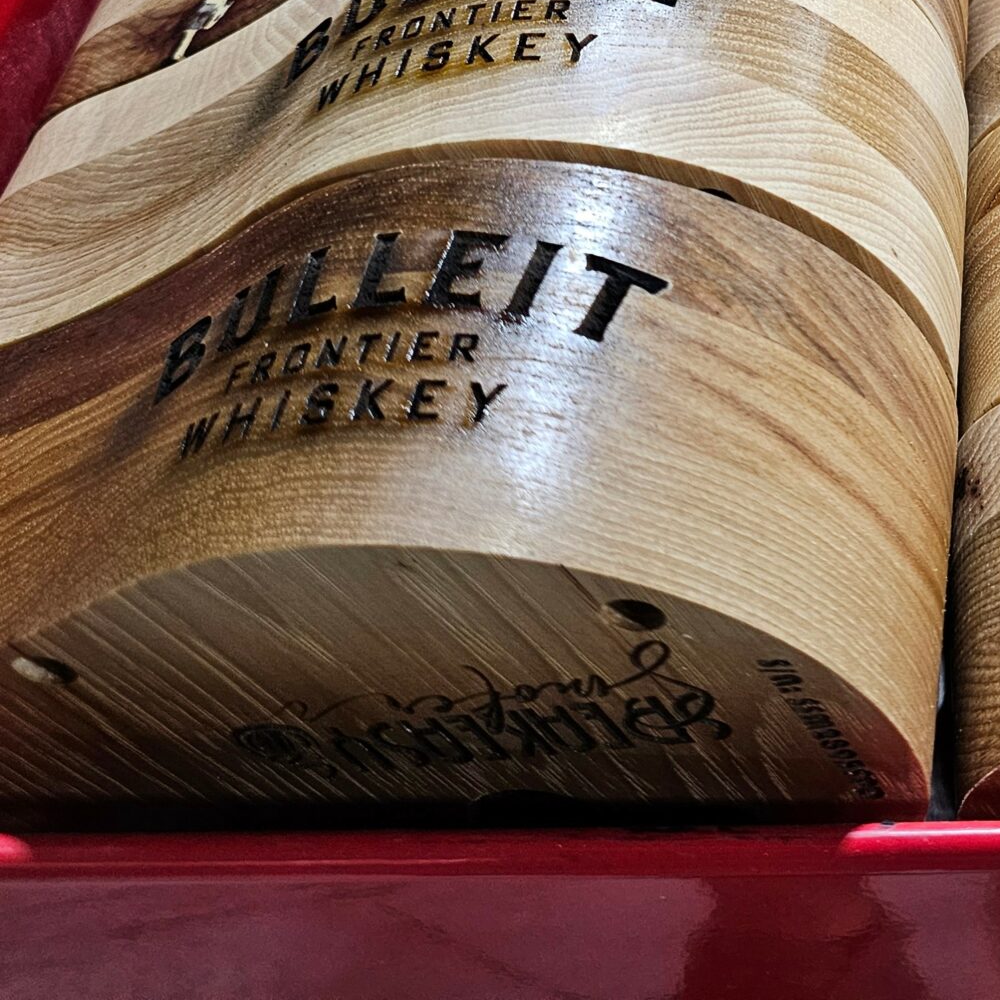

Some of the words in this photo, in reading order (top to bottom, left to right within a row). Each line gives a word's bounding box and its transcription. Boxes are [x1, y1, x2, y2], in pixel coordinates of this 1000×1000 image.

[351, 0, 571, 61] FRONTIER
[317, 32, 599, 111] WHISKEY
[153, 229, 672, 404] BULLEIT
[225, 330, 481, 393] FRONTIER
[180, 378, 507, 459] WHISKEY
